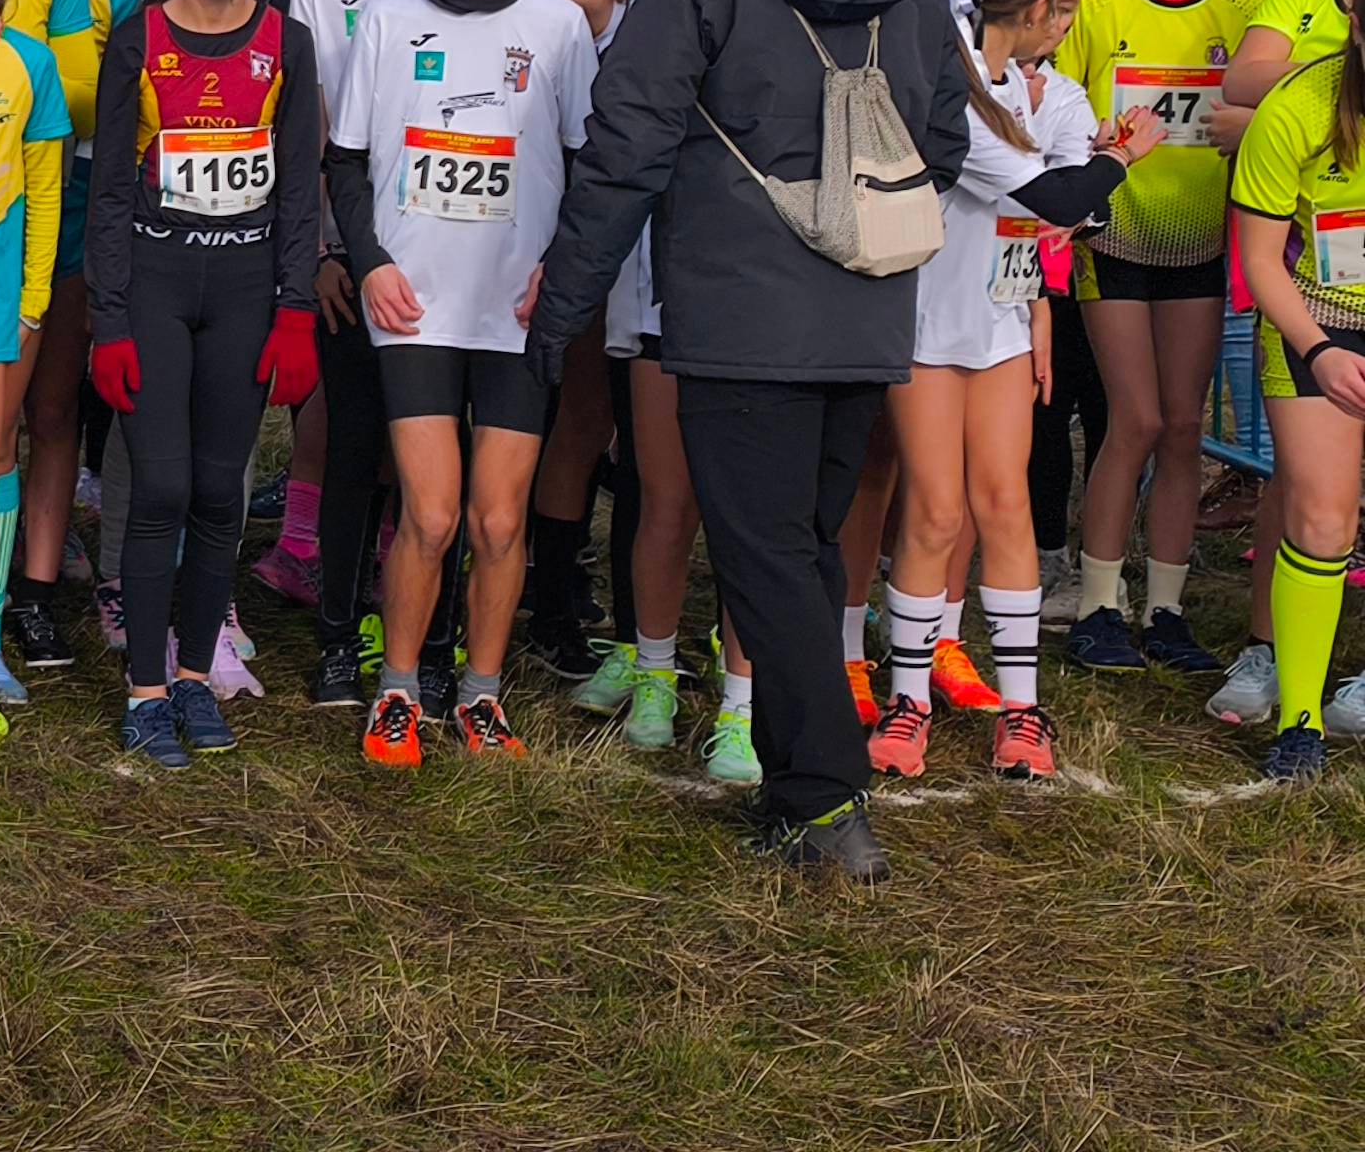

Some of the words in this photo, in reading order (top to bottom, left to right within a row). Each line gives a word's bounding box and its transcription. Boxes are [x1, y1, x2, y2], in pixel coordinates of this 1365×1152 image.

[183, 115, 238, 129] VINO
[177, 153, 270, 194] 1165
[414, 154, 511, 198] 1325
[184, 227, 266, 247] NIKE
